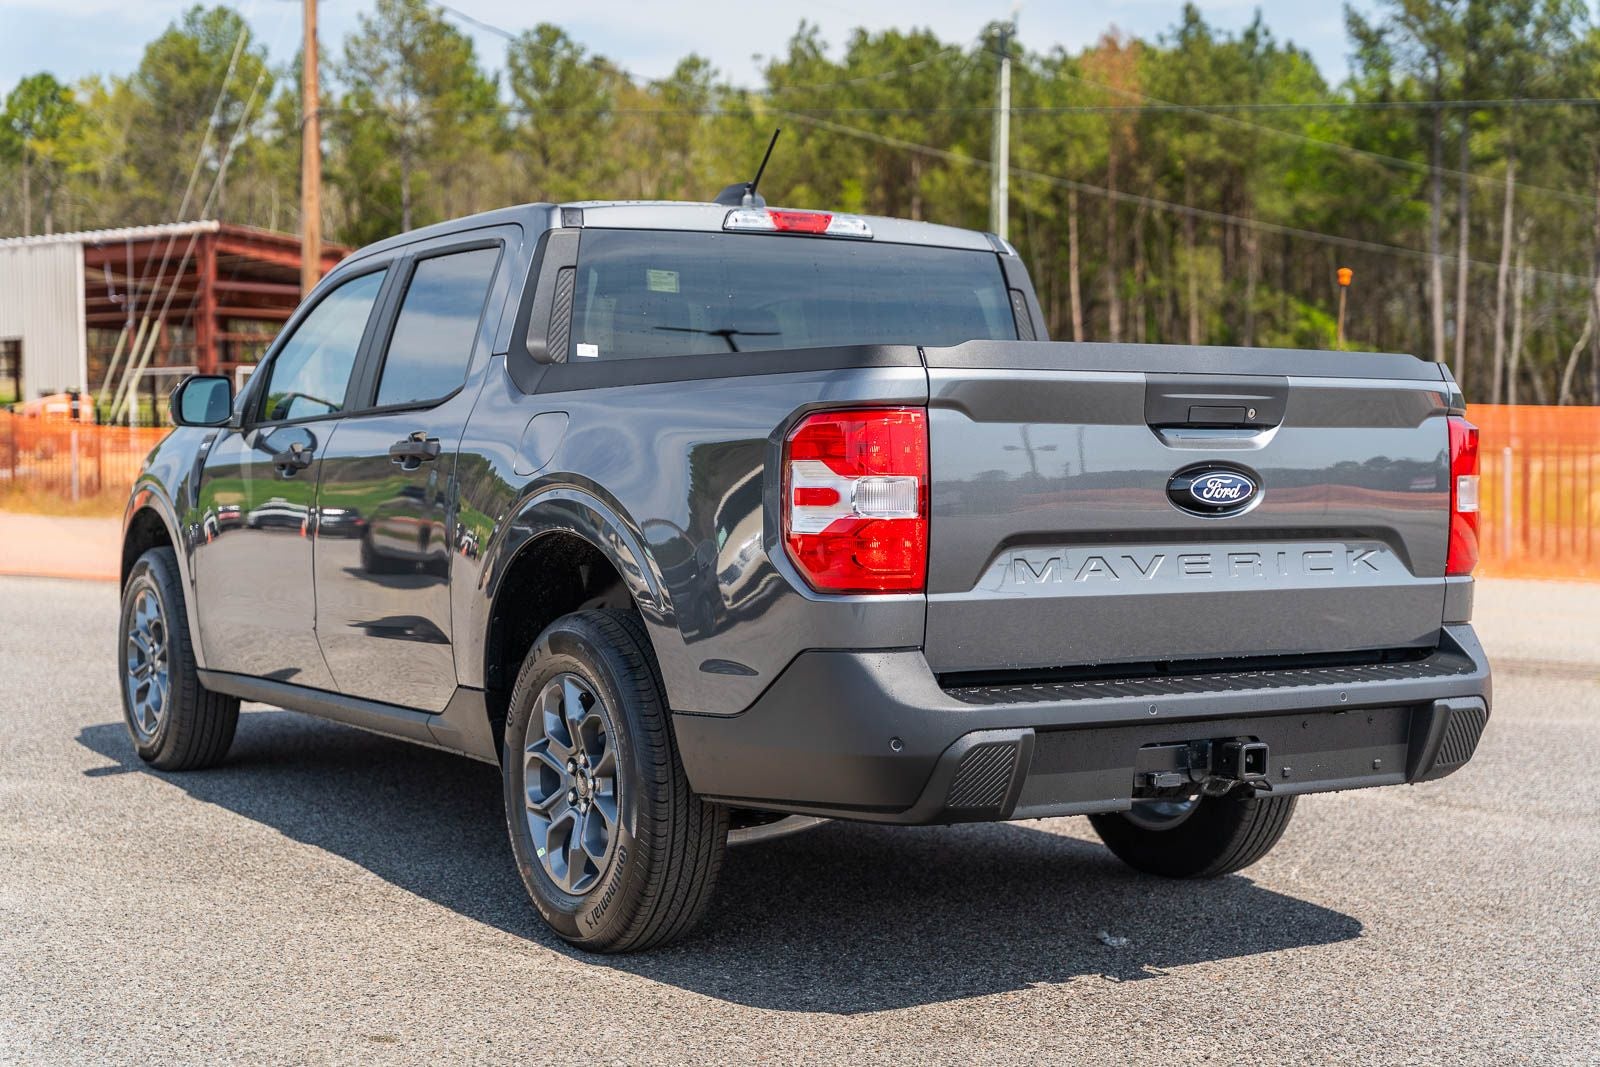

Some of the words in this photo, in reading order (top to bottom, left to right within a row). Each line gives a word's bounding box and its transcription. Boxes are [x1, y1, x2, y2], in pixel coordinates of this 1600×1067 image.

[1203, 478, 1241, 498] Ford
[1013, 550, 1380, 584] MAVERICK
[591, 845, 627, 925] Continental
